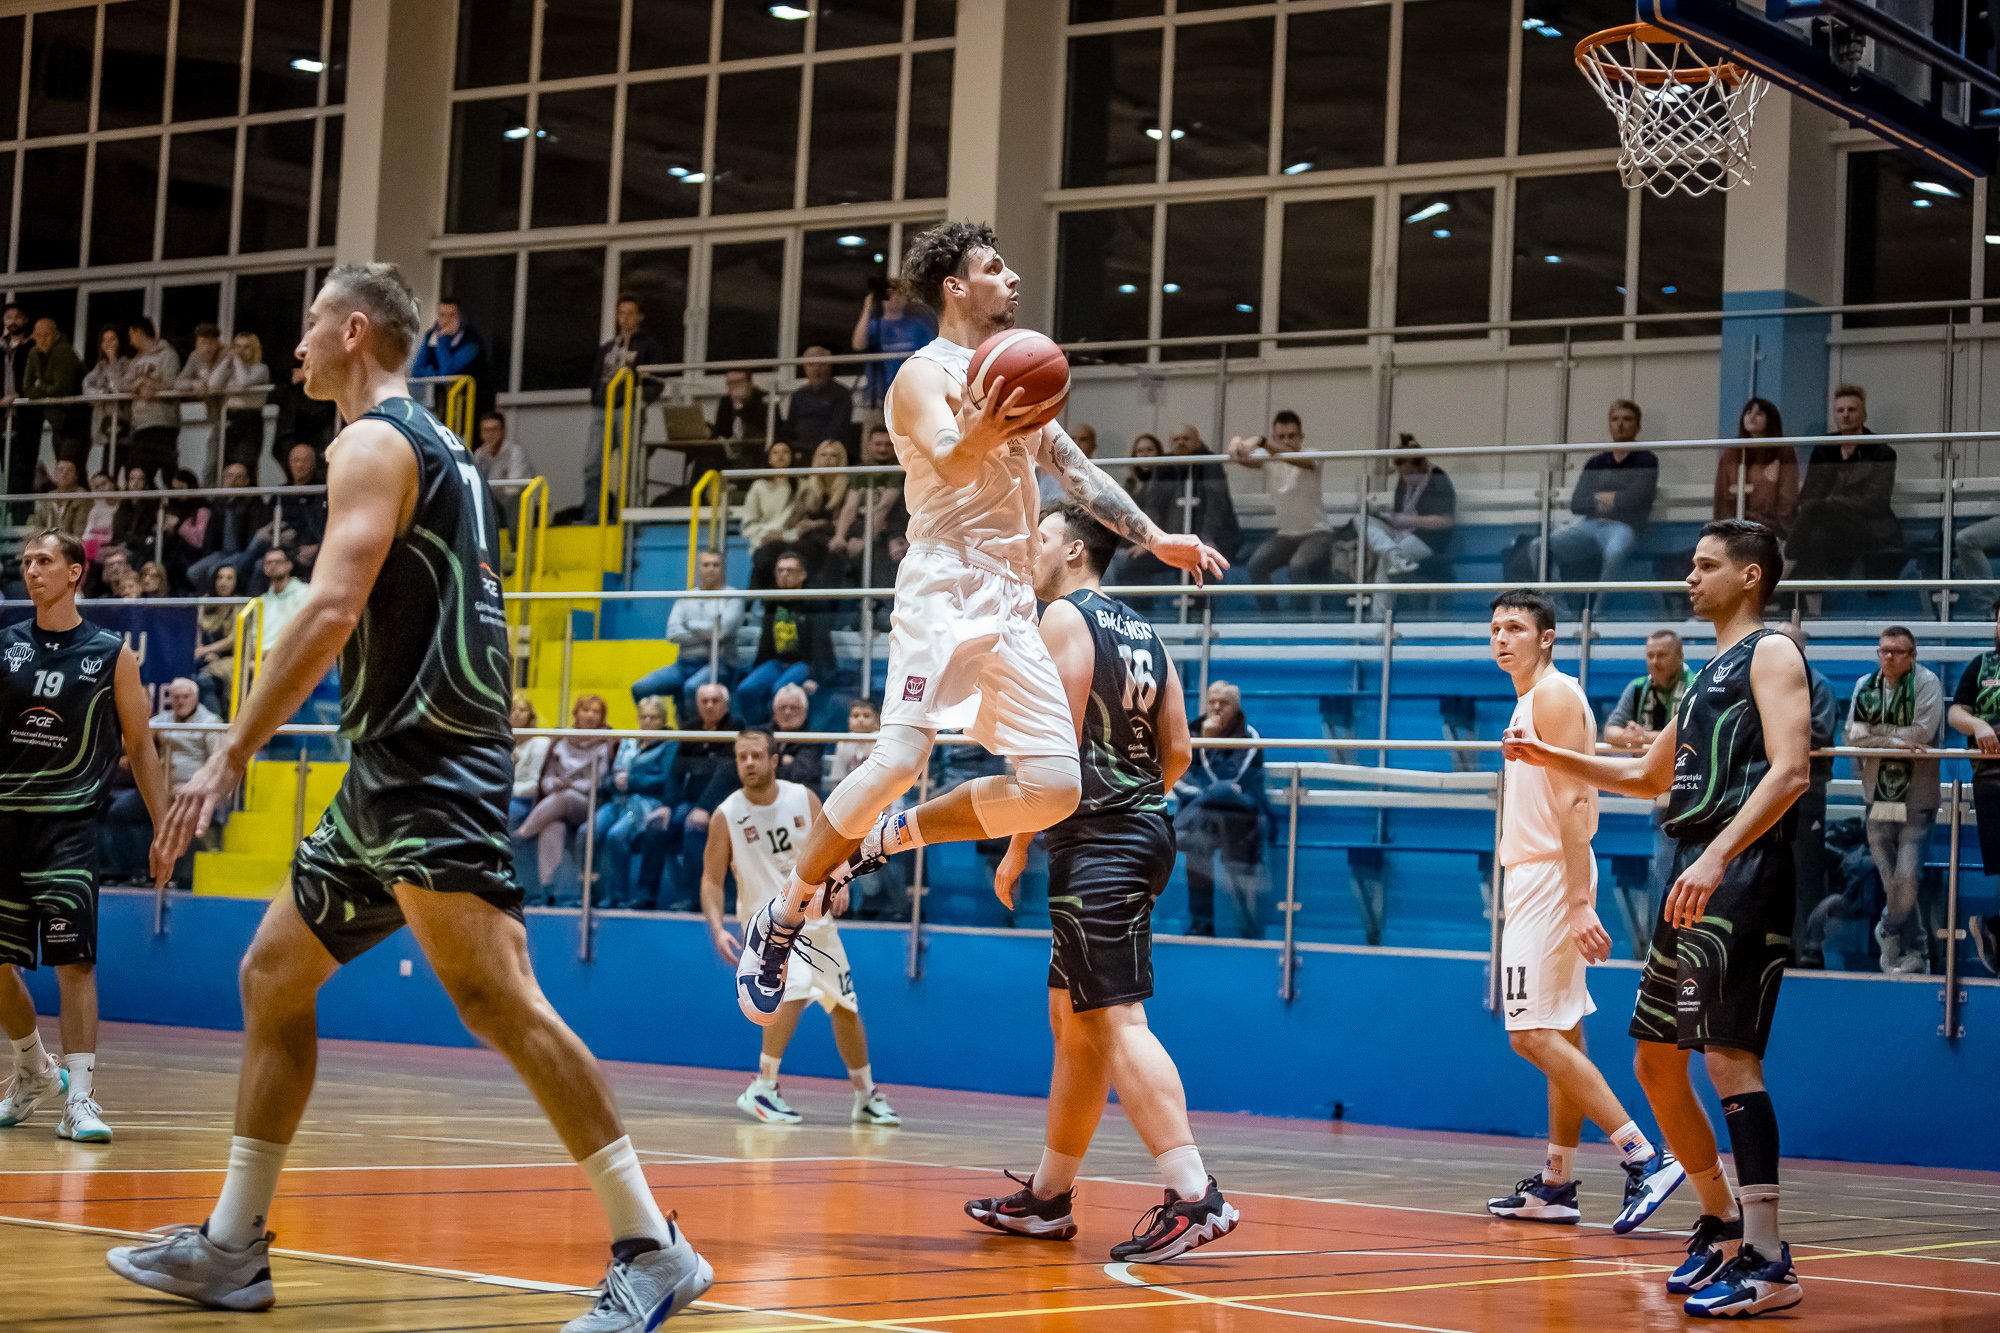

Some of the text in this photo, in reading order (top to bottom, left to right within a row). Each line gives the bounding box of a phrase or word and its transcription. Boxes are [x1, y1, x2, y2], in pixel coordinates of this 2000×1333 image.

[32, 669, 65, 698] 19
[26, 715, 54, 728] PGE
[767, 827, 792, 854] 12
[1506, 966, 1527, 1000] 11
